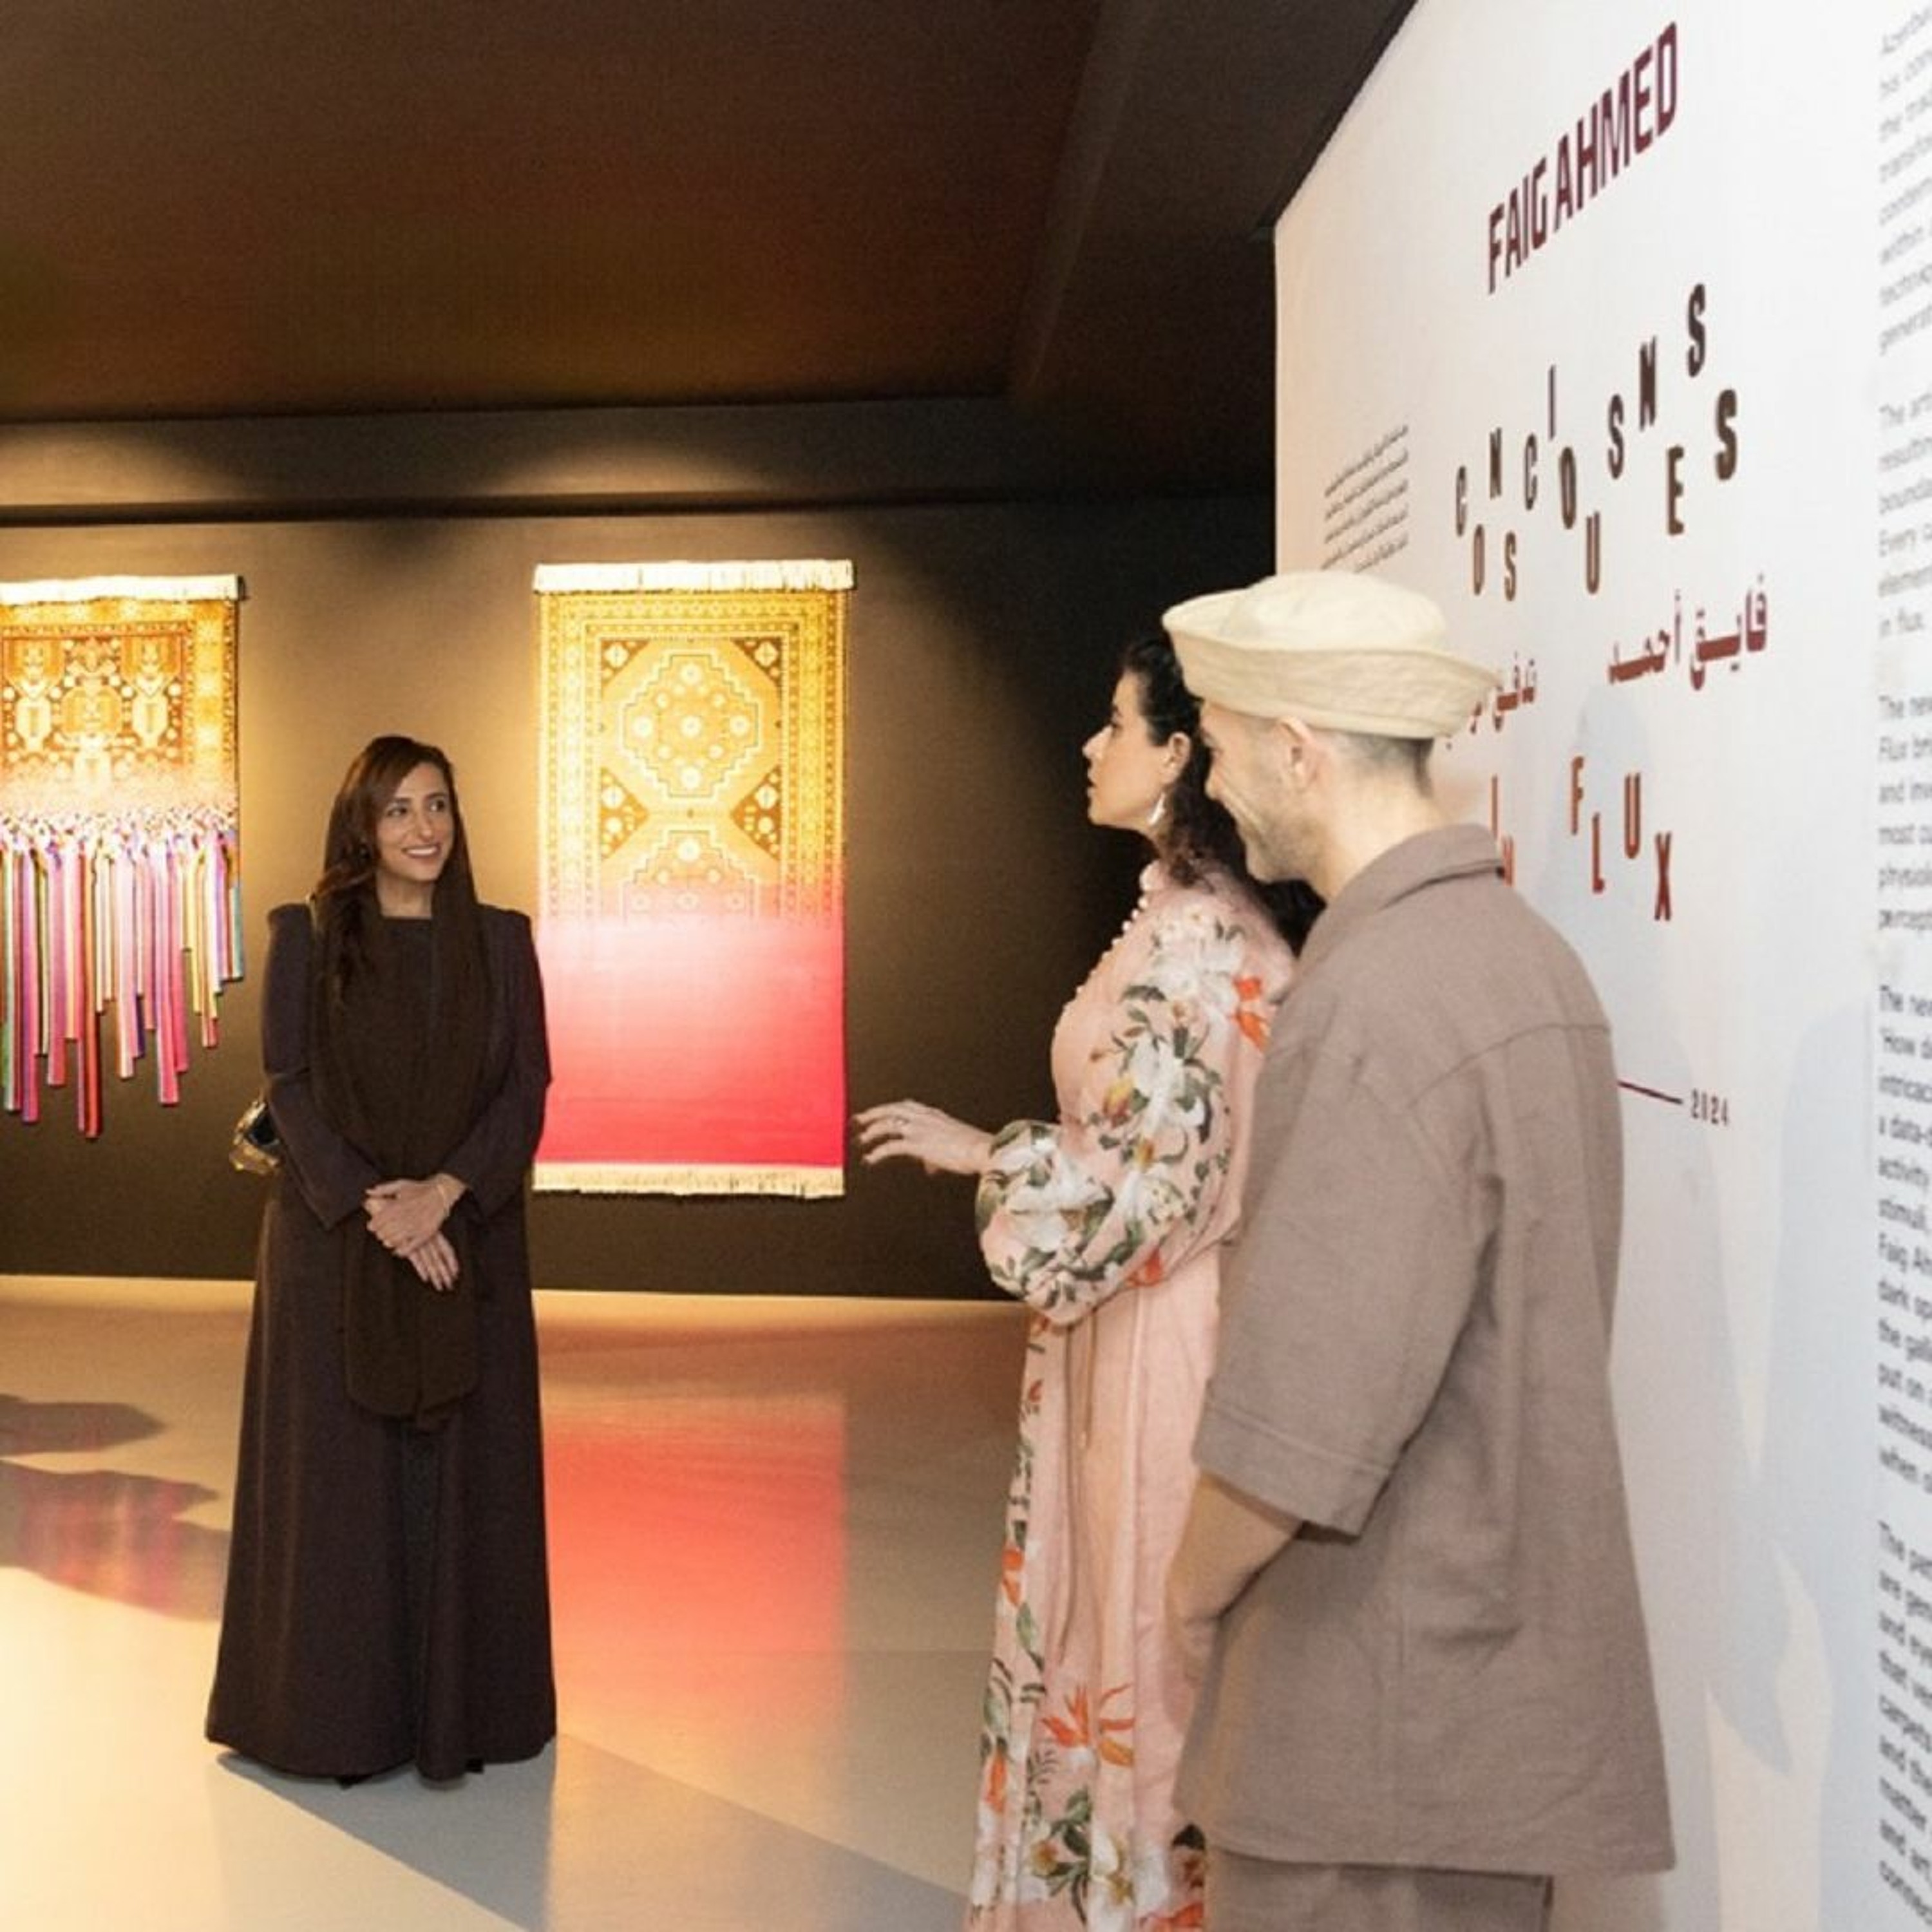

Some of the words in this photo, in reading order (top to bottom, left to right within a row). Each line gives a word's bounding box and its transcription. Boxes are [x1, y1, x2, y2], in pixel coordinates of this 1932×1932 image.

[1488, 156, 1548, 295] FAIG
[1553, 21, 1678, 232] AHMED
[1879, 404, 1904, 427] The
[1879, 529, 1917, 557] Every
[1879, 695, 1905, 719] The
[1879, 736, 1907, 762] Flux
[1879, 781, 1905, 804] and
[1571, 755, 1672, 922] FLUX
[1879, 824, 1916, 845] most
[1879, 985, 1903, 1012] The
[1690, 1088, 1729, 1127] 2024
[1879, 1232, 1907, 1273] Faig
[1879, 1319, 1901, 1348] the
[1879, 1520, 1906, 1561] The
